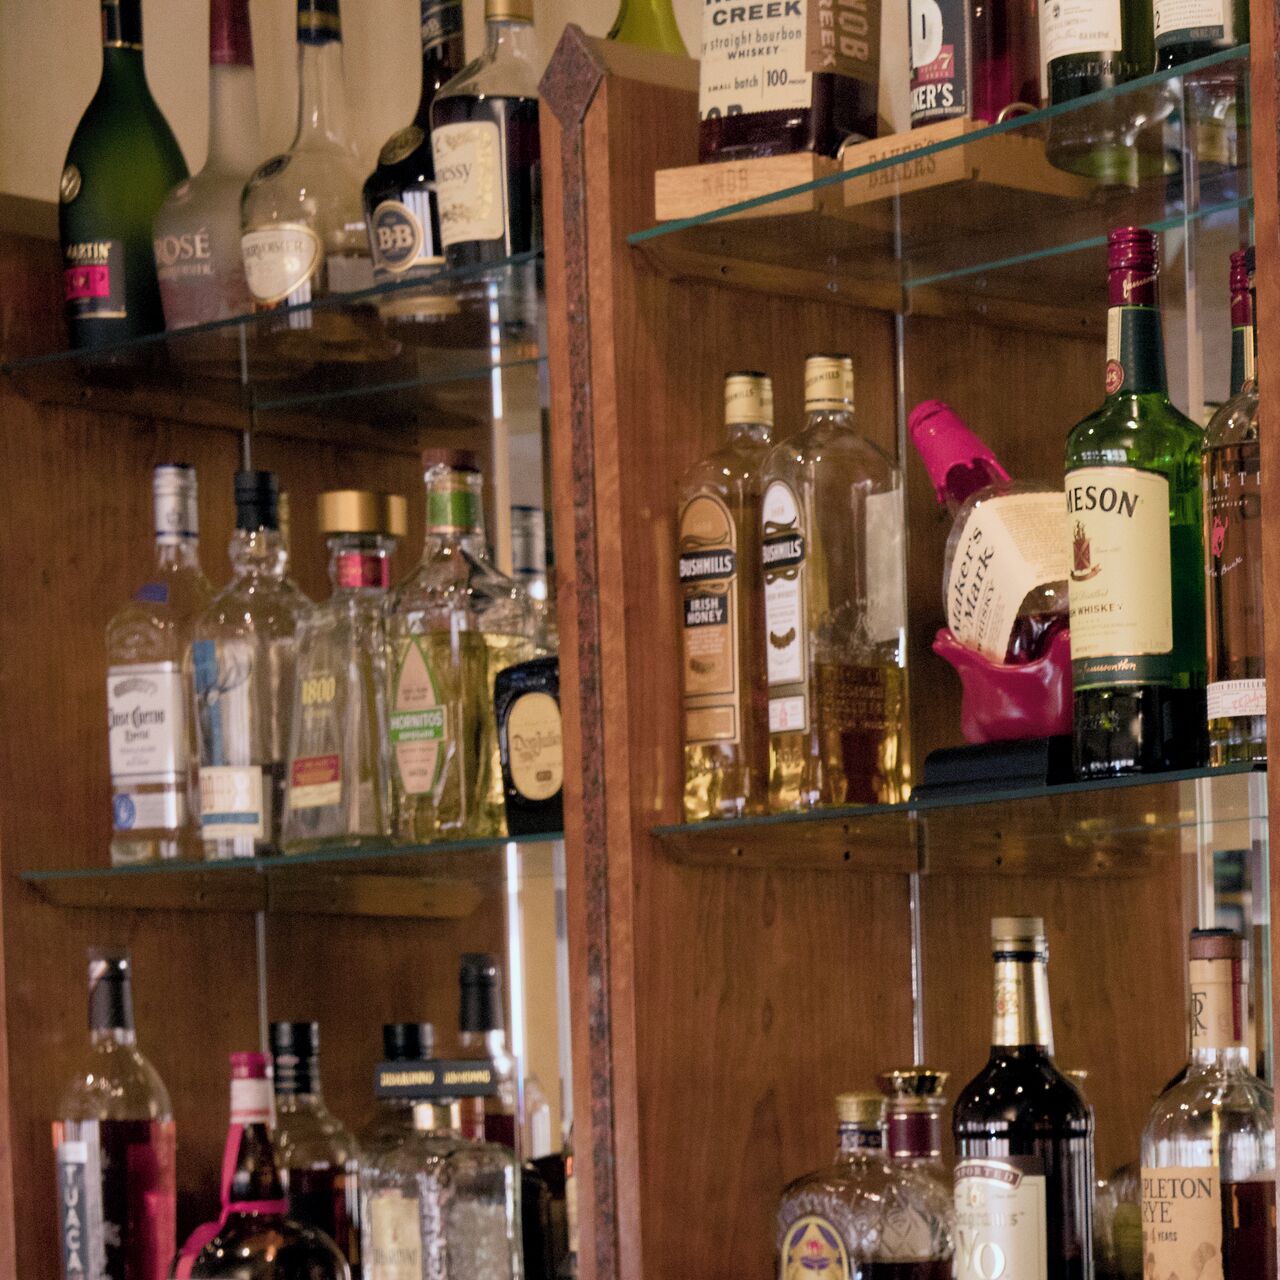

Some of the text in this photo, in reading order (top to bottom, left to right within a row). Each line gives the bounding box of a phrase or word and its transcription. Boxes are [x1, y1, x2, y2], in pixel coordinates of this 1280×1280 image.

[711, 1, 802, 26] CREEK
[710, 25, 802, 52] straight bourbon
[728, 46, 779, 60] WHISKEY
[734, 69, 788, 89] batch 100
[763, 539, 802, 564] BUSHMILLS
[679, 555, 733, 578] BUSHMILLS
[963, 546, 995, 630] Mark
[690, 597, 719, 612] IRISH
[687, 608, 723, 625] HONEY
[302, 677, 336, 705] 1800
[390, 712, 442, 730] HORNITOS
[63, 1164, 83, 1276] TUACA
[1157, 1231, 1178, 1242] YEARS
